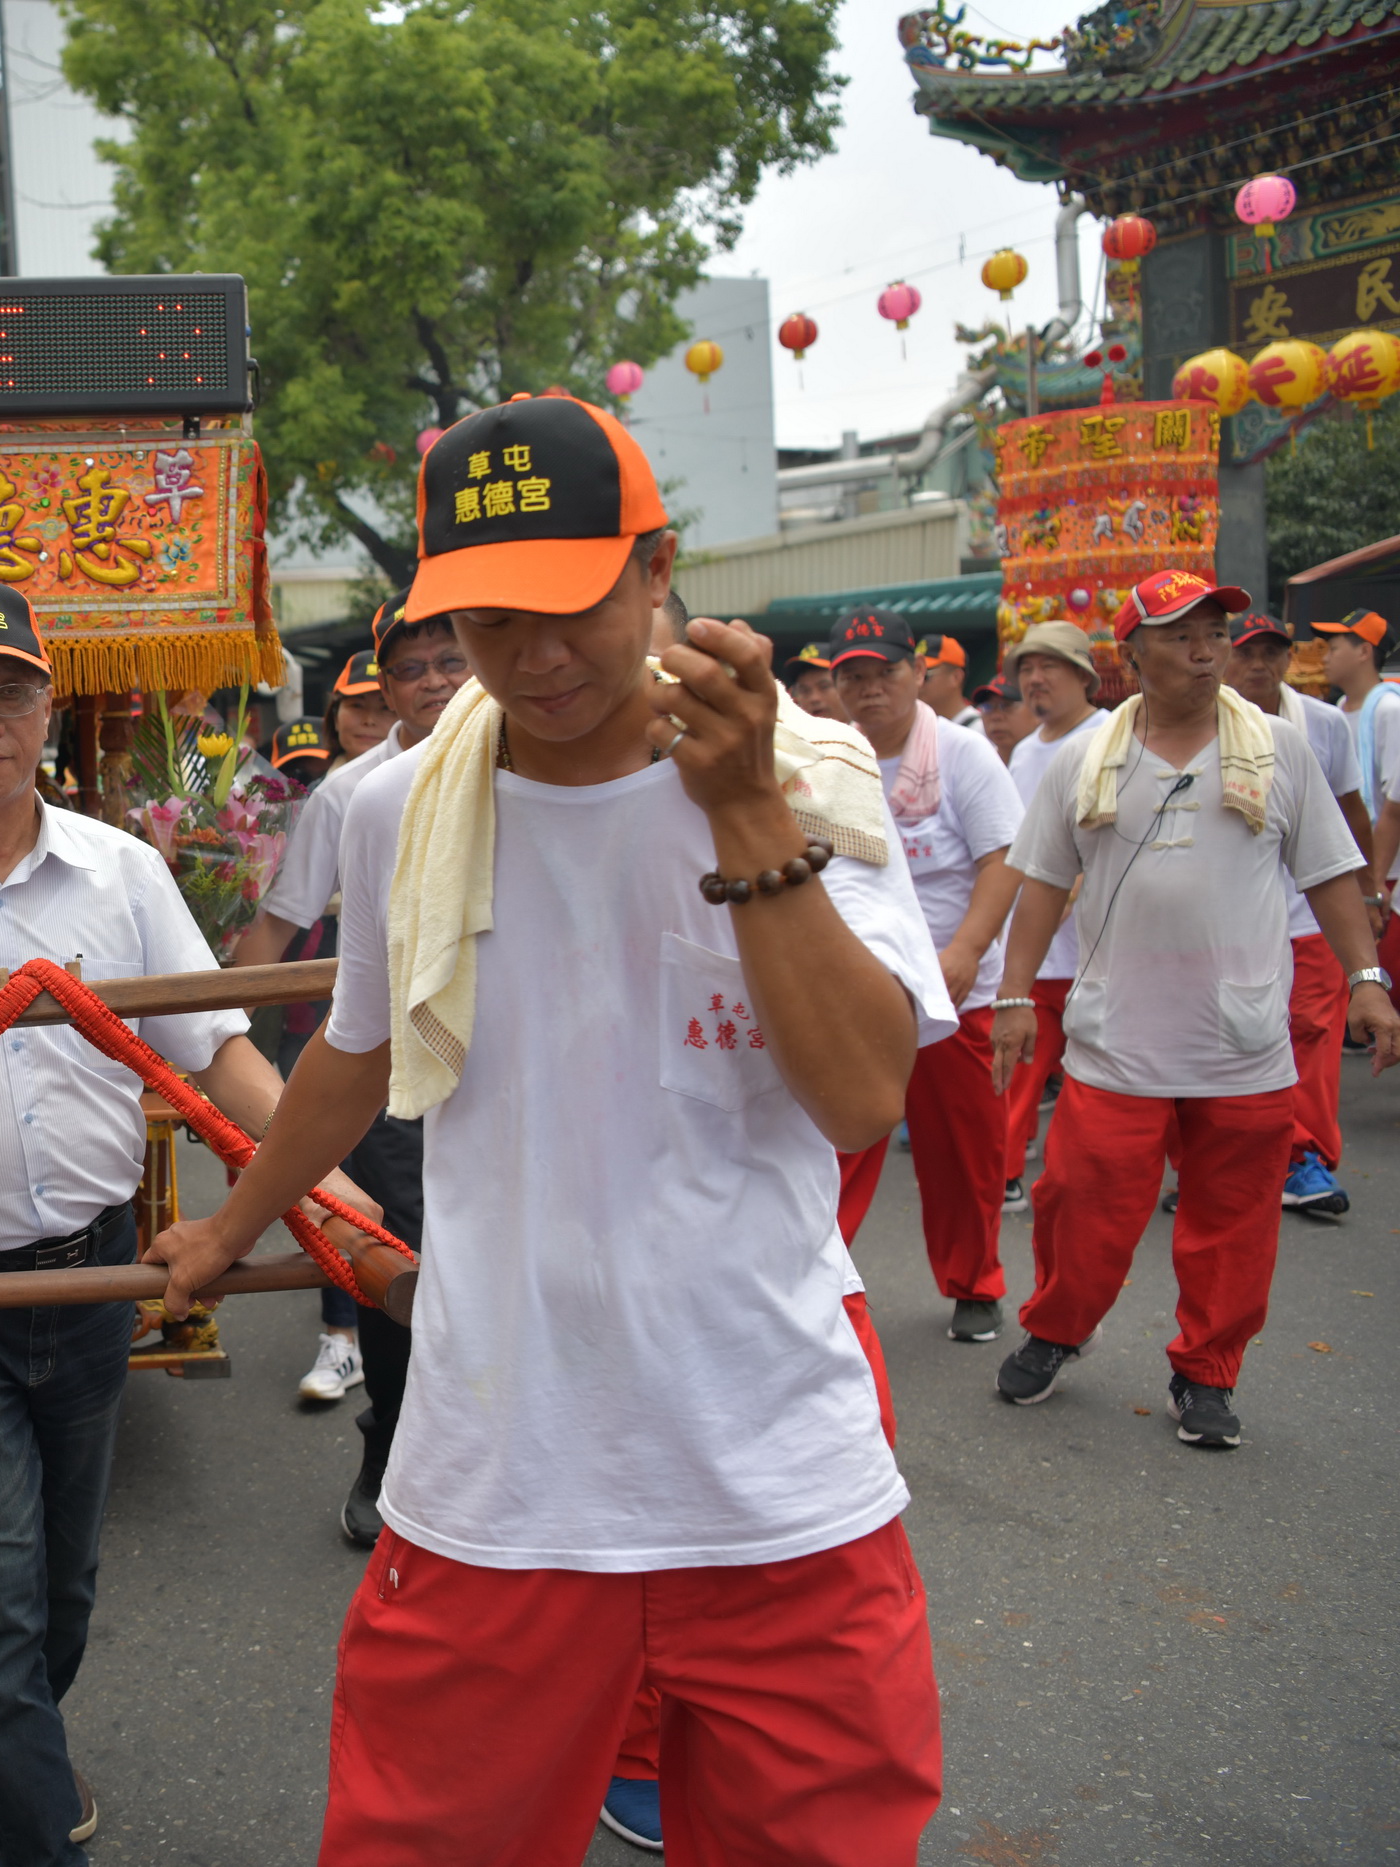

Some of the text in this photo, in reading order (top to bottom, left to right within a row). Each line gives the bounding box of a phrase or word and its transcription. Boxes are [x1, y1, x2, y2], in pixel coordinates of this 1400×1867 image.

[467, 444, 532, 480] 草屯
[144, 448, 204, 524] 草
[454, 476, 551, 524] 惠德宮
[707, 993, 750, 1020] 草屯
[683, 1016, 766, 1050] 惠德宮
